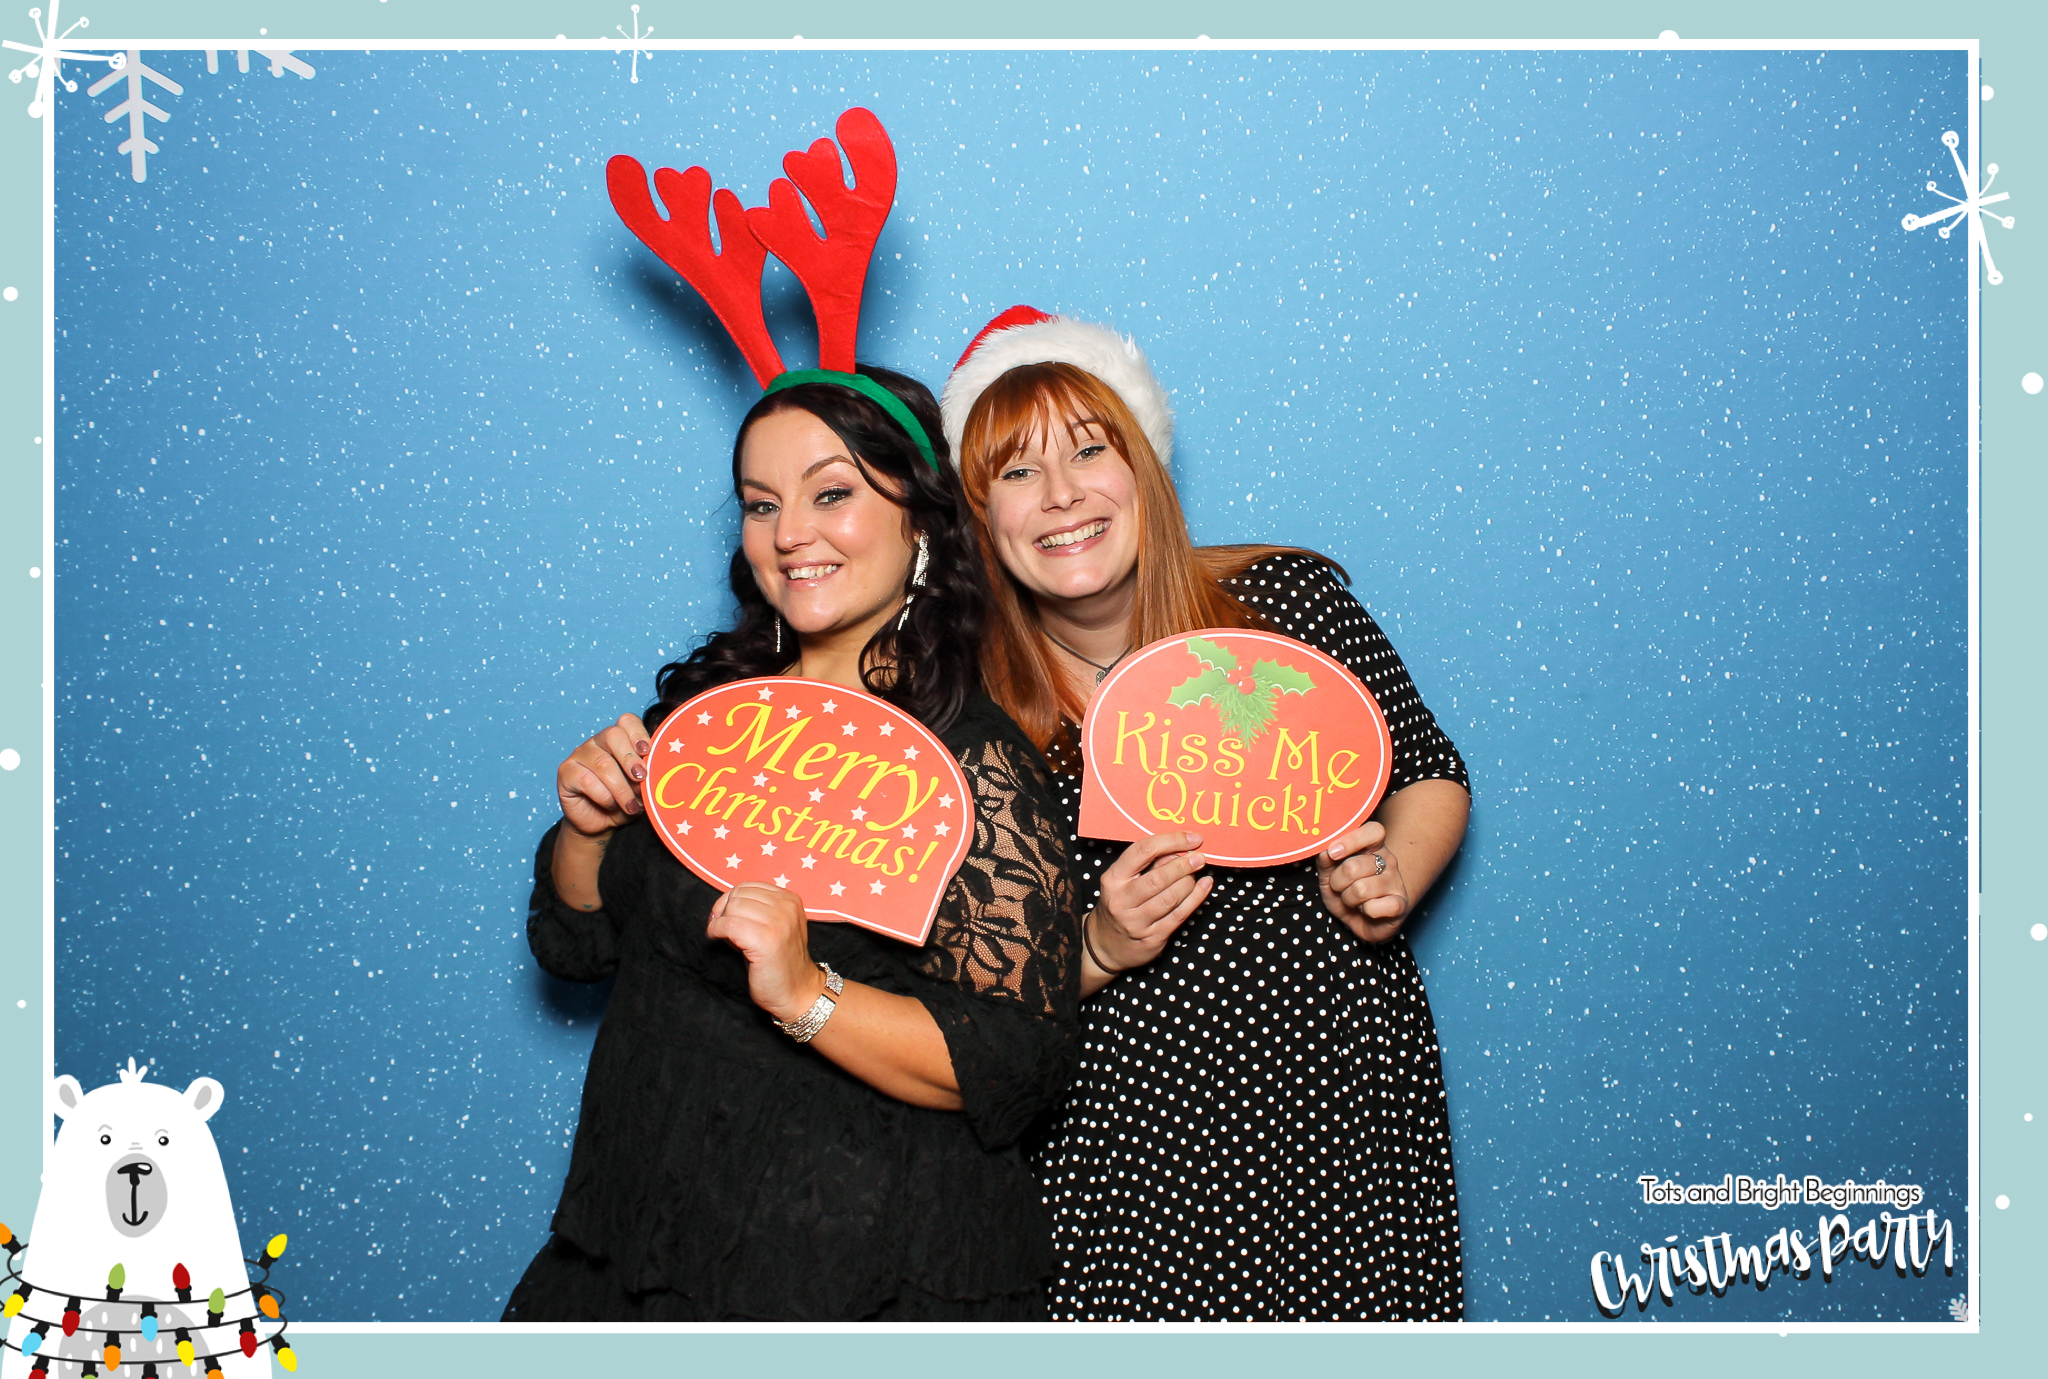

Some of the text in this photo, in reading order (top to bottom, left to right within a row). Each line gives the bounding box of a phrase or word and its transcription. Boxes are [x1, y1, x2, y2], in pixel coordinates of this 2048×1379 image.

[706, 702, 940, 832] Merry
[1112, 710, 1361, 794] Kiss Me
[1146, 771, 1325, 836] Quick!
[654, 762, 940, 884] Christmas!
